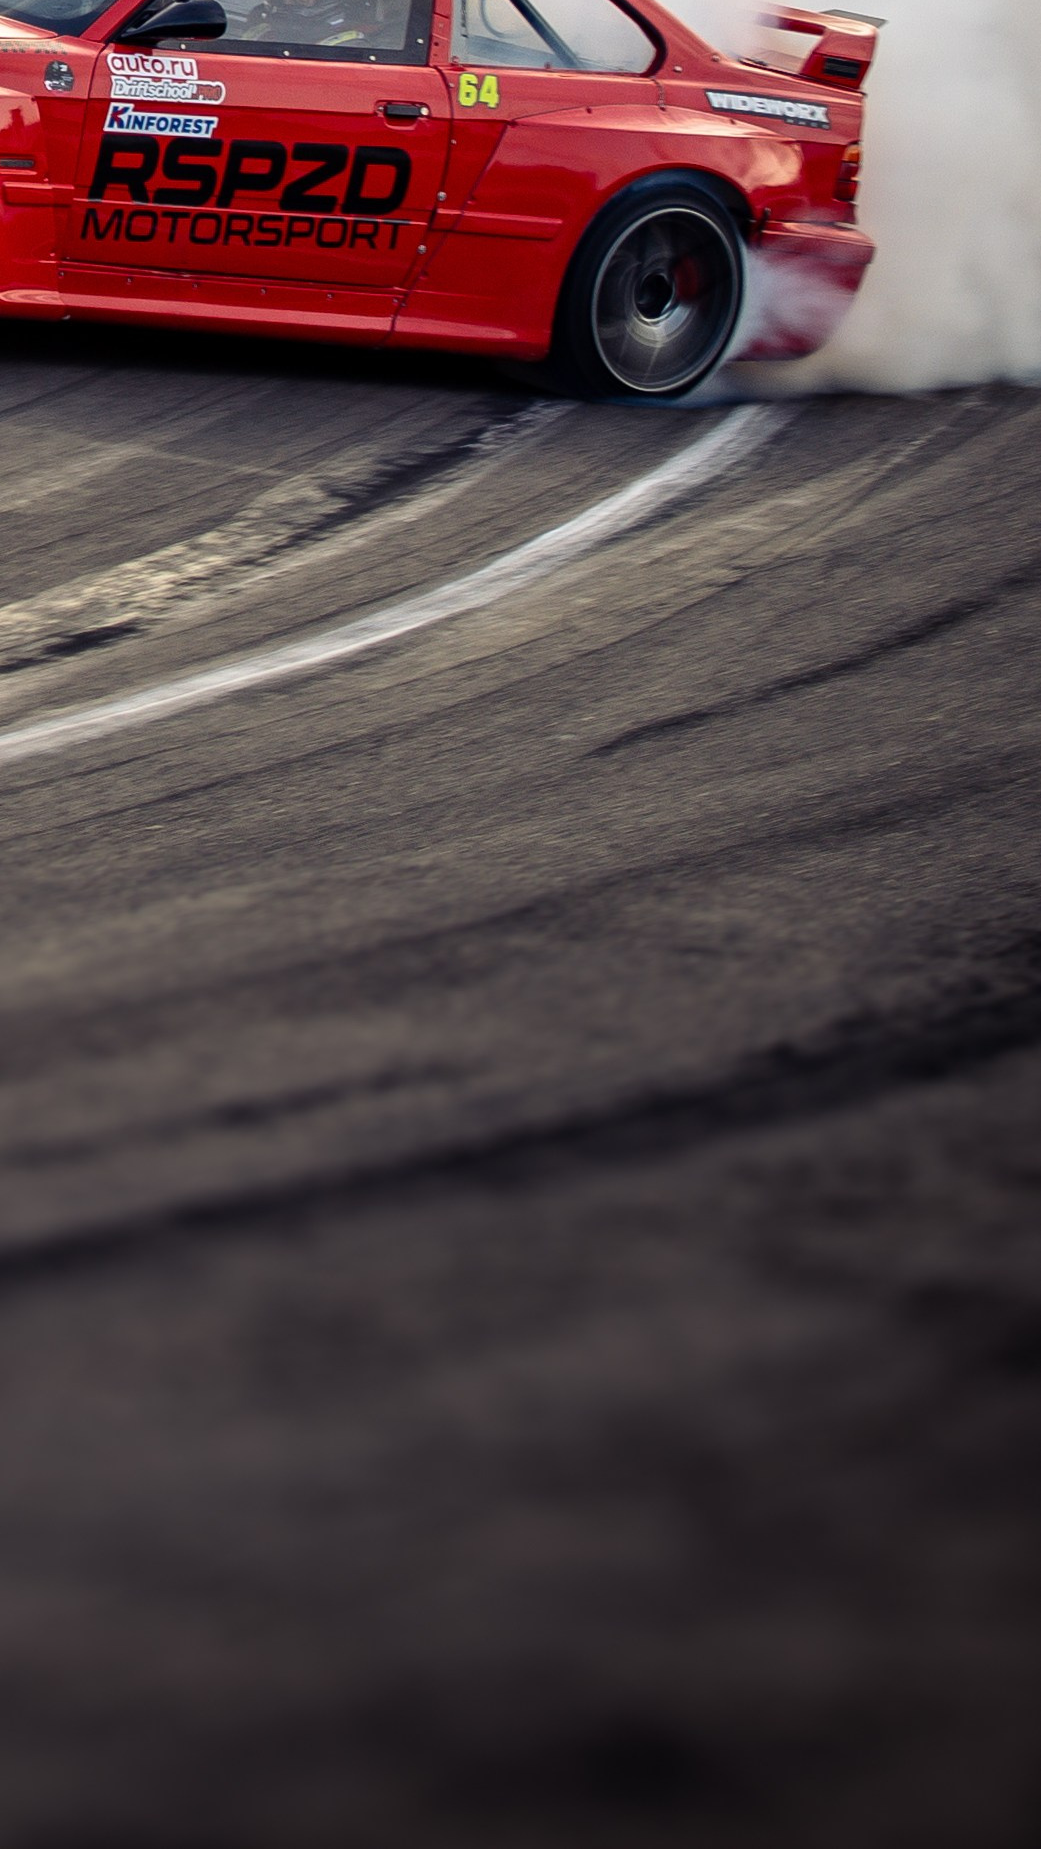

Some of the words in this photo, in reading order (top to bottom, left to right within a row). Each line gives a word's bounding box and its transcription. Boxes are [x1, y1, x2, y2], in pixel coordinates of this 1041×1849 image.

[111, 55, 195, 77] auto.ru
[458, 72, 500, 109] 64
[705, 91, 830, 123] WIDEWORX
[107, 105, 217, 135] KINFOREST
[87, 132, 413, 216] RSPZD
[79, 206, 415, 251] MOTORSPORT
